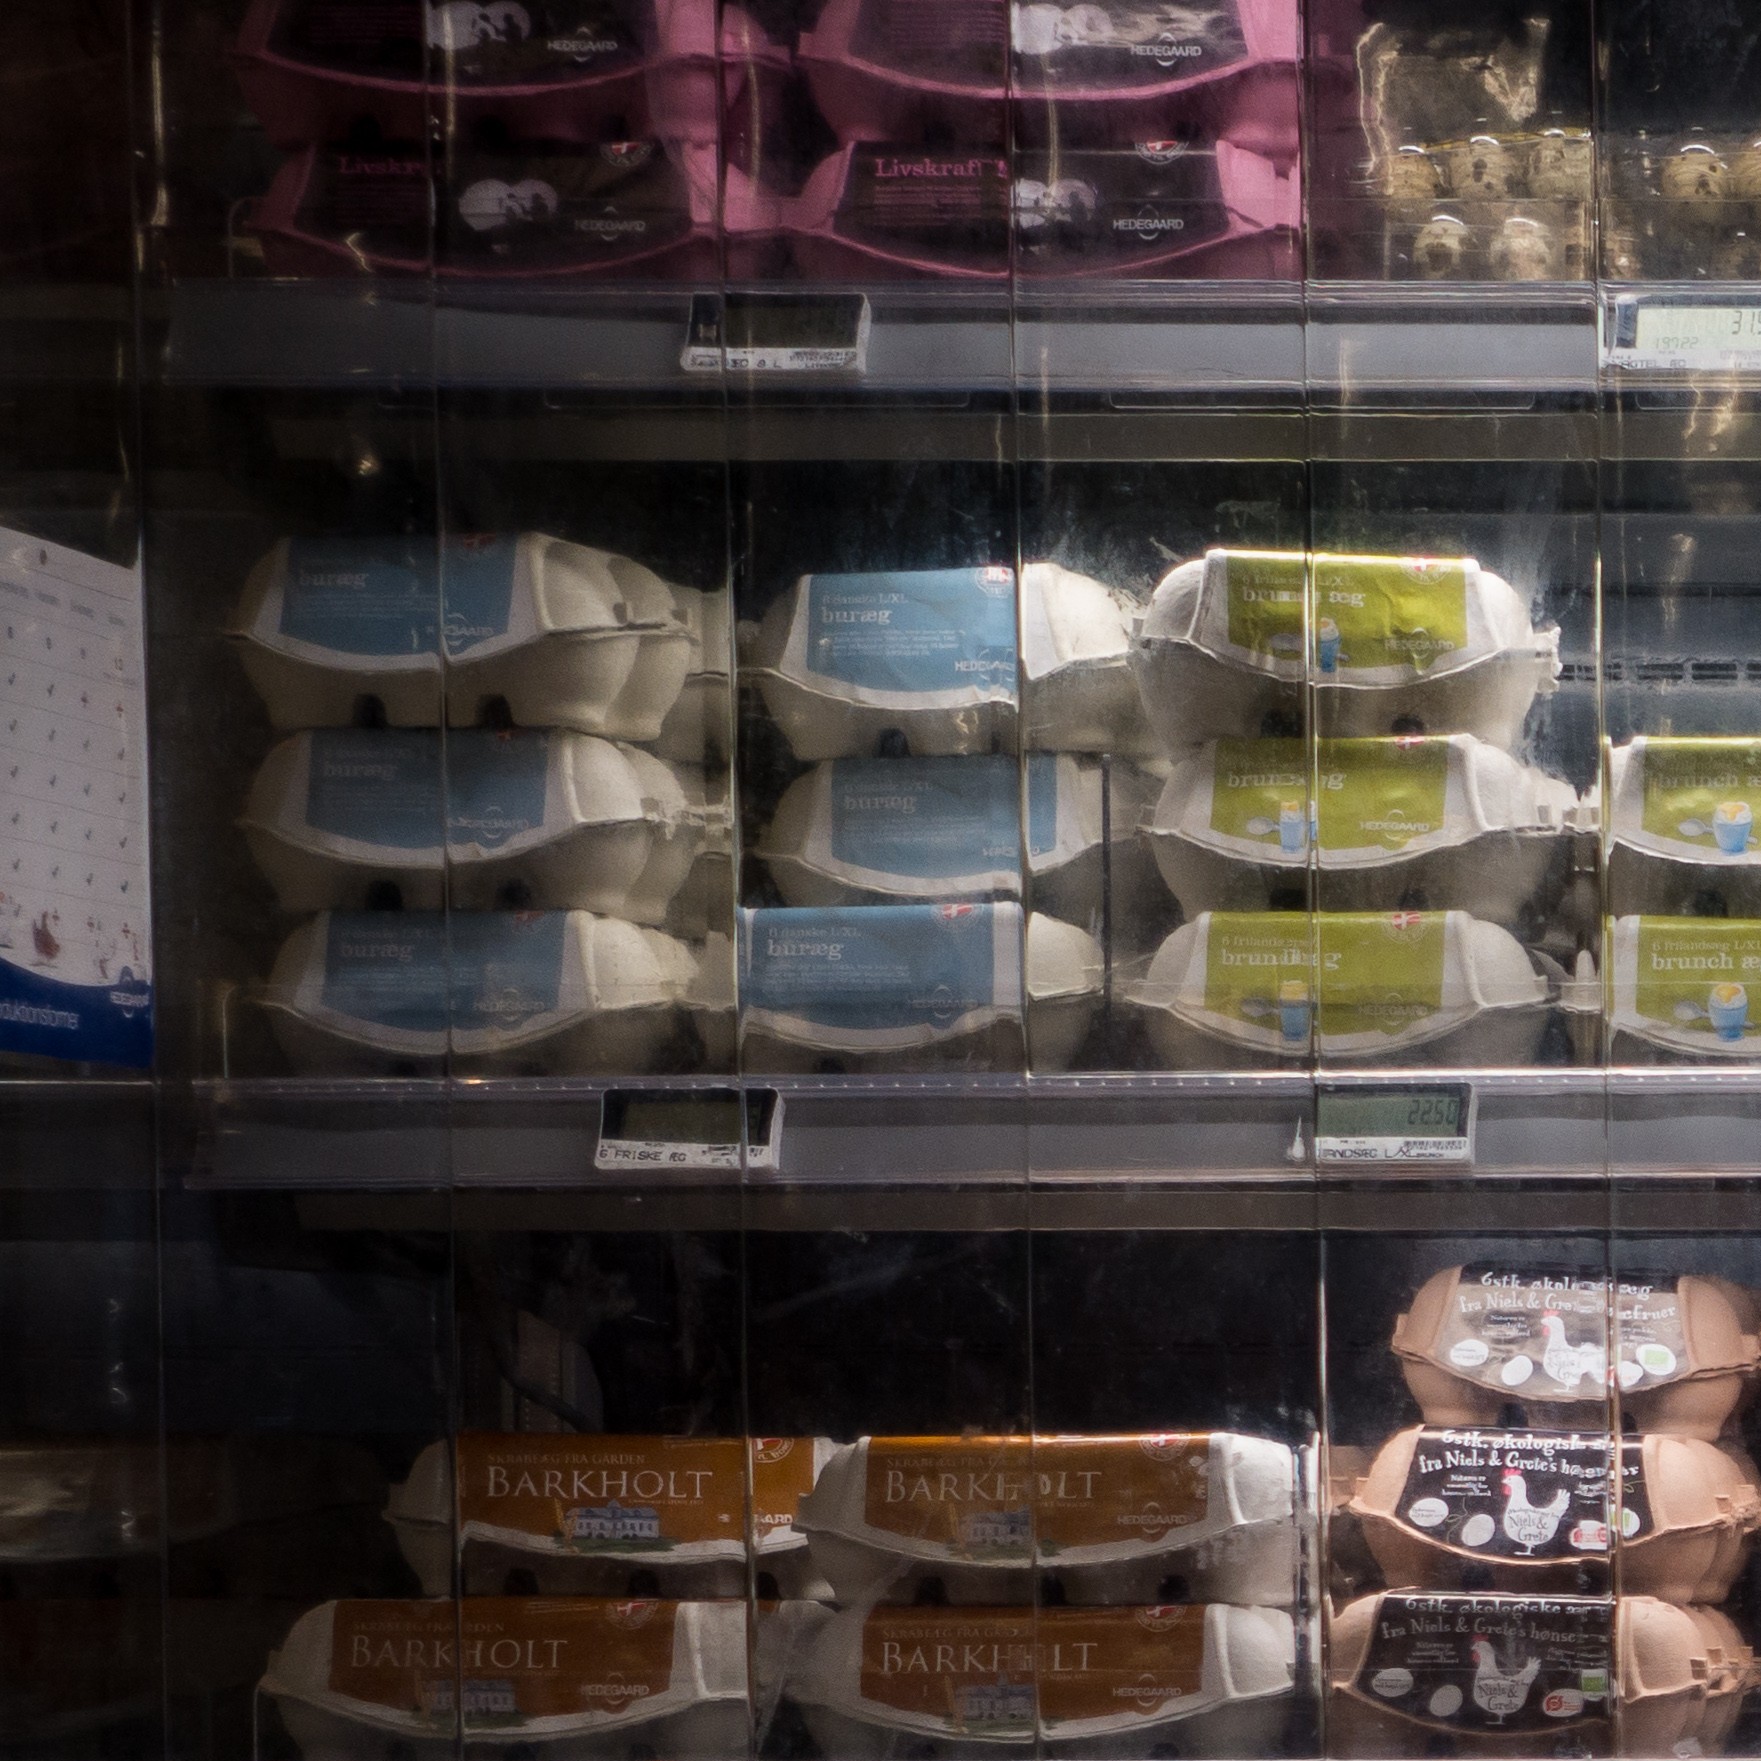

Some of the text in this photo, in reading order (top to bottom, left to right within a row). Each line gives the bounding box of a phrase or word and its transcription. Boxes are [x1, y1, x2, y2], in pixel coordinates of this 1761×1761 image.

[1113, 218, 1184, 231] HEDEGAARD
[820, 606, 891, 627] buræg
[767, 939, 844, 961] buræg
[1651, 951, 1737, 970] brunch
[614, 1149, 663, 1162] FRISKE
[561, 1454, 584, 1465] FRA
[1445, 1452, 1557, 1472] Niels & Grete's
[487, 1468, 713, 1500] BARKHOLT
[1411, 1618, 1451, 1635] Niels
[350, 1635, 567, 1669] BARKHOLT
